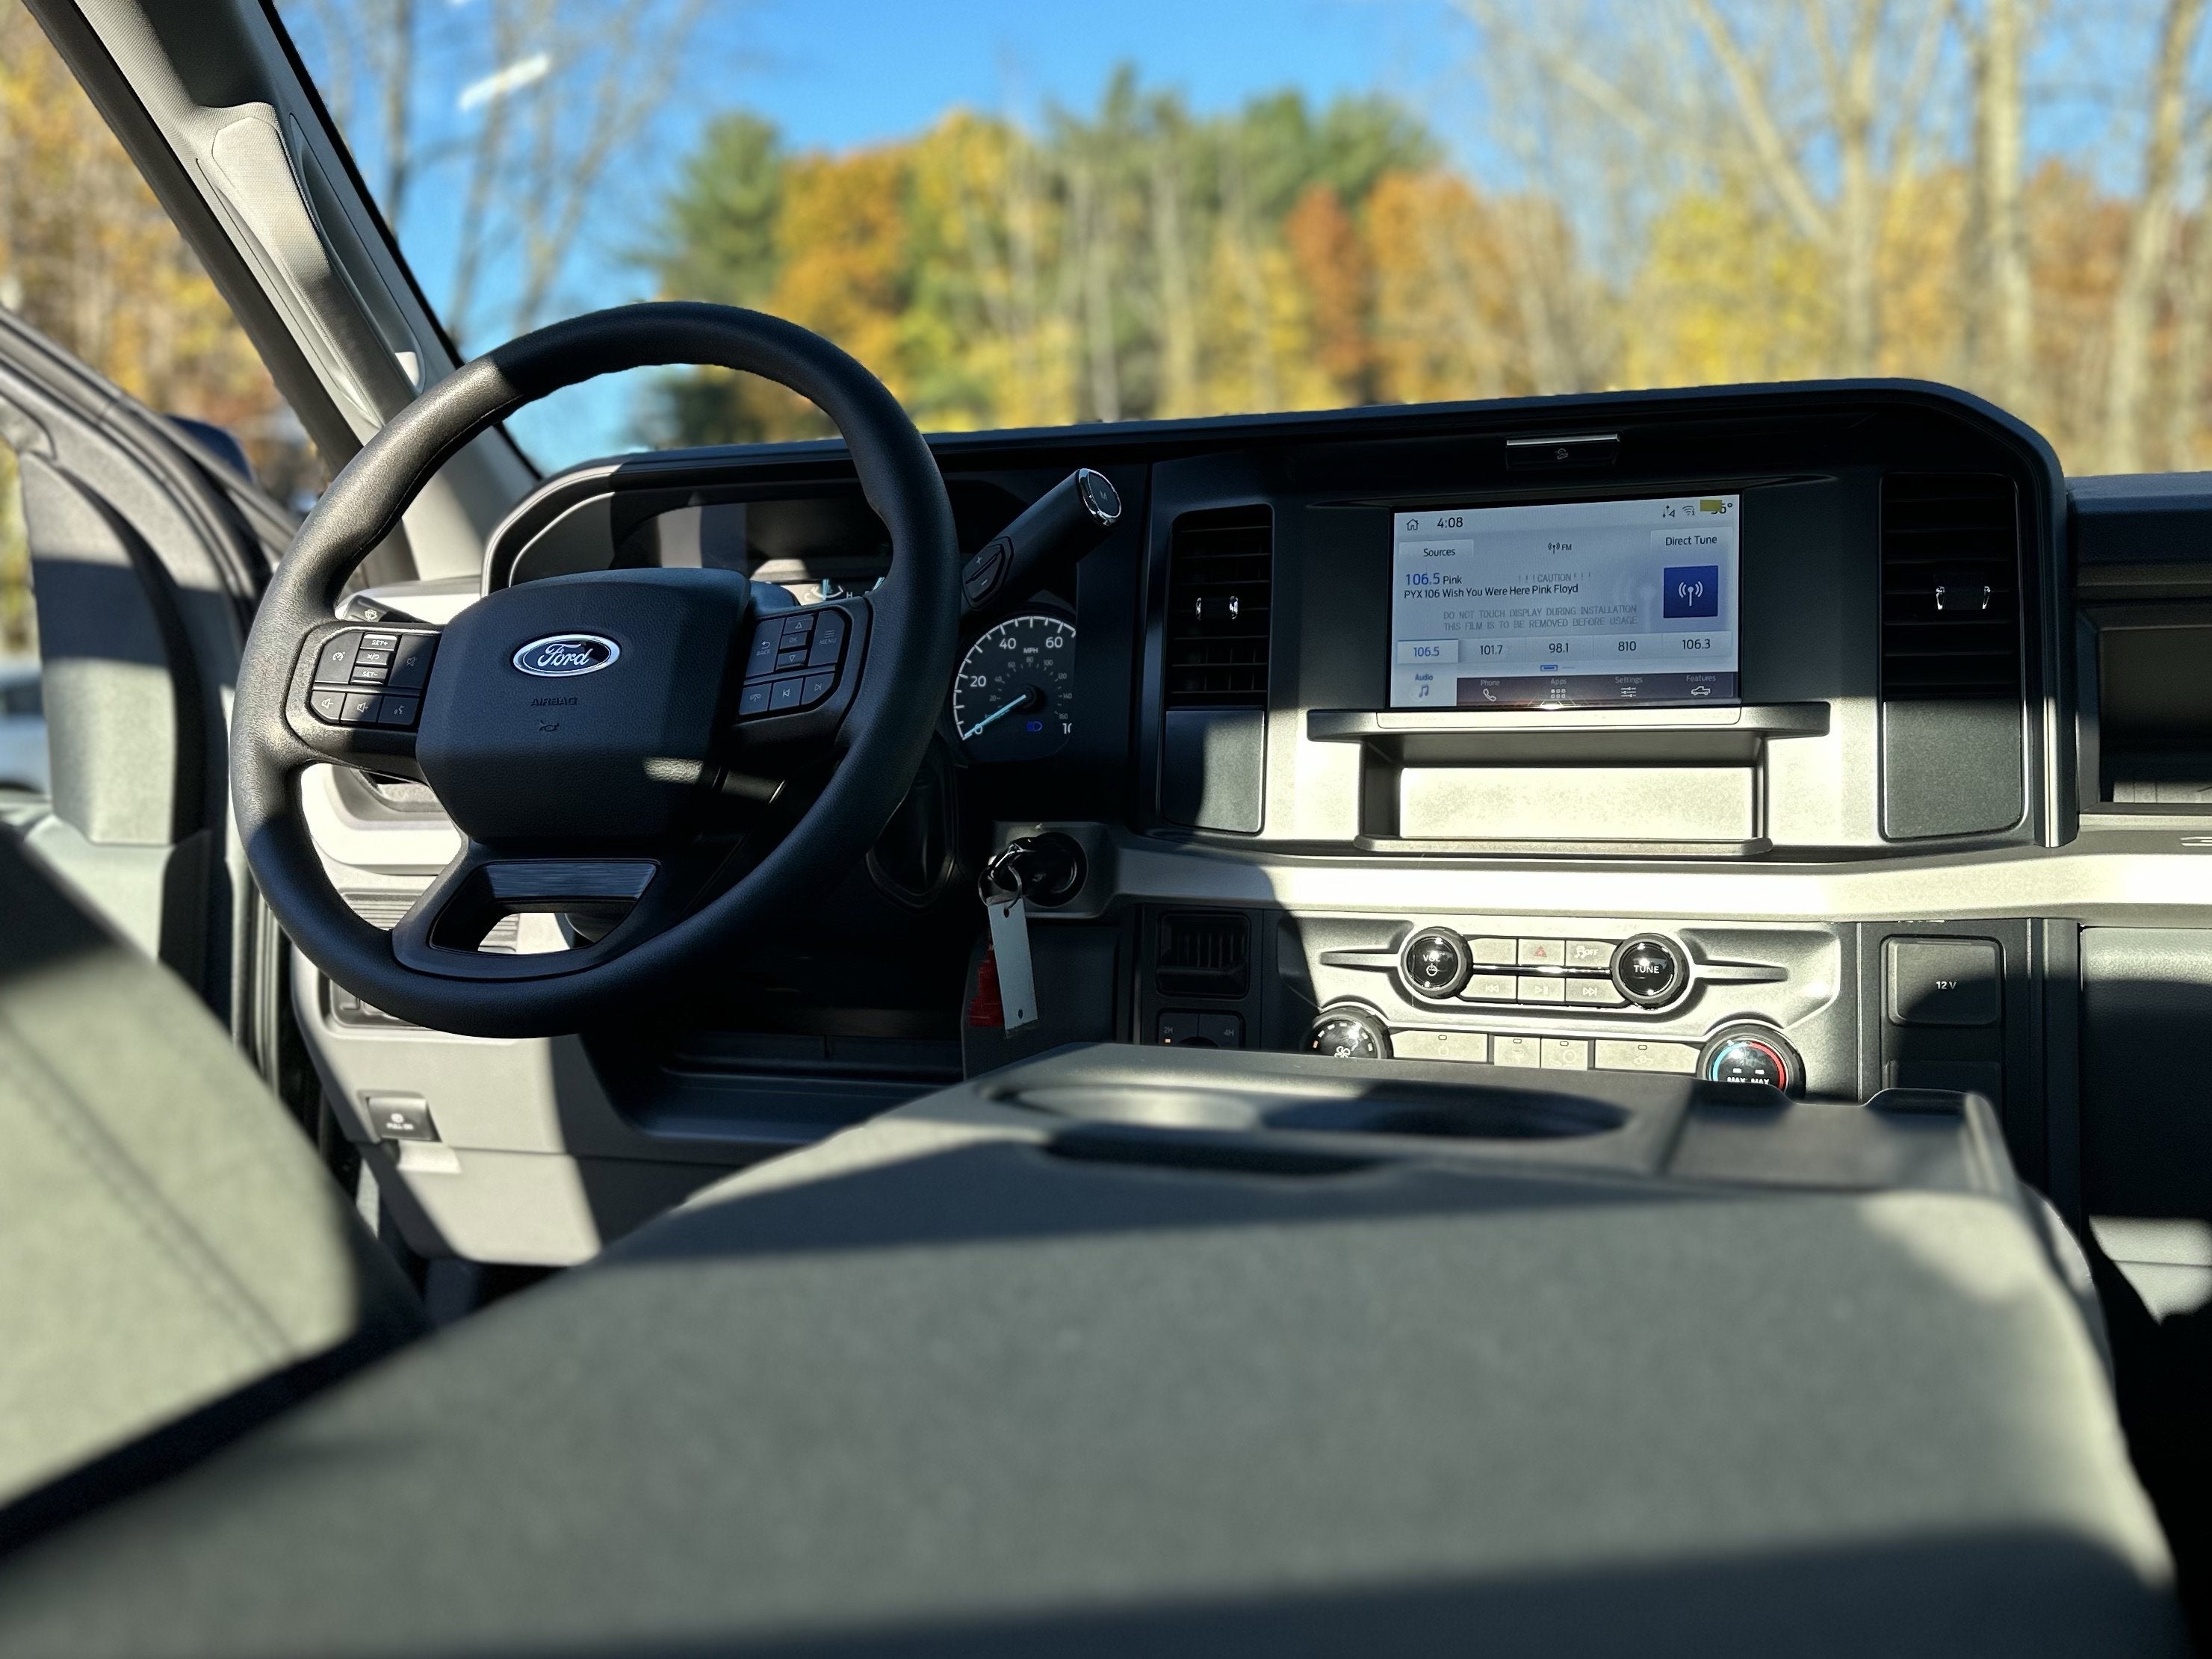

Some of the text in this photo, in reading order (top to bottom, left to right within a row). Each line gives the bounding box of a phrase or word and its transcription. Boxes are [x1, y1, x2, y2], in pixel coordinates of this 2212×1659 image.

[1437, 516, 1464, 529] 4:08
[1665, 535, 1717, 546] Direct Tune
[1422, 547, 1456, 557] Sources
[1561, 543, 1573, 551] FM
[1404, 572, 1463, 586] 106.5 Pink
[1537, 573, 1572, 583] CAUTION
[1404, 583, 1579, 599] PYX 106 Wish You Were Here Pink Floyd
[1443, 604, 1638, 620] DO NOT TOUCH DISPLAY DURING INSTALLATION
[1444, 615, 1638, 631] THIS FILM IS TO BE REMOVED BEFORE USAGE
[999, 637, 1017, 650] 40
[1045, 636, 1063, 648] 60
[1617, 641, 1637, 651] 810
[1682, 639, 1711, 650] 106.3
[1413, 646, 1440, 657] 106.5
[1480, 645, 1503, 656] 101.7
[1549, 642, 1570, 654] 98.1
[536, 643, 594, 667] Ford
[970, 675, 987, 687] 20
[1480, 679, 1500, 687] Phone
[1550, 677, 1567, 686] Apps
[1614, 676, 1643, 685] Settings
[1685, 675, 1717, 683] Features
[530, 696, 578, 707] AIRBAG
[1422, 953, 1441, 962] VOL
[1633, 964, 1660, 974] TUNE
[1936, 980, 1957, 990] 12 V
